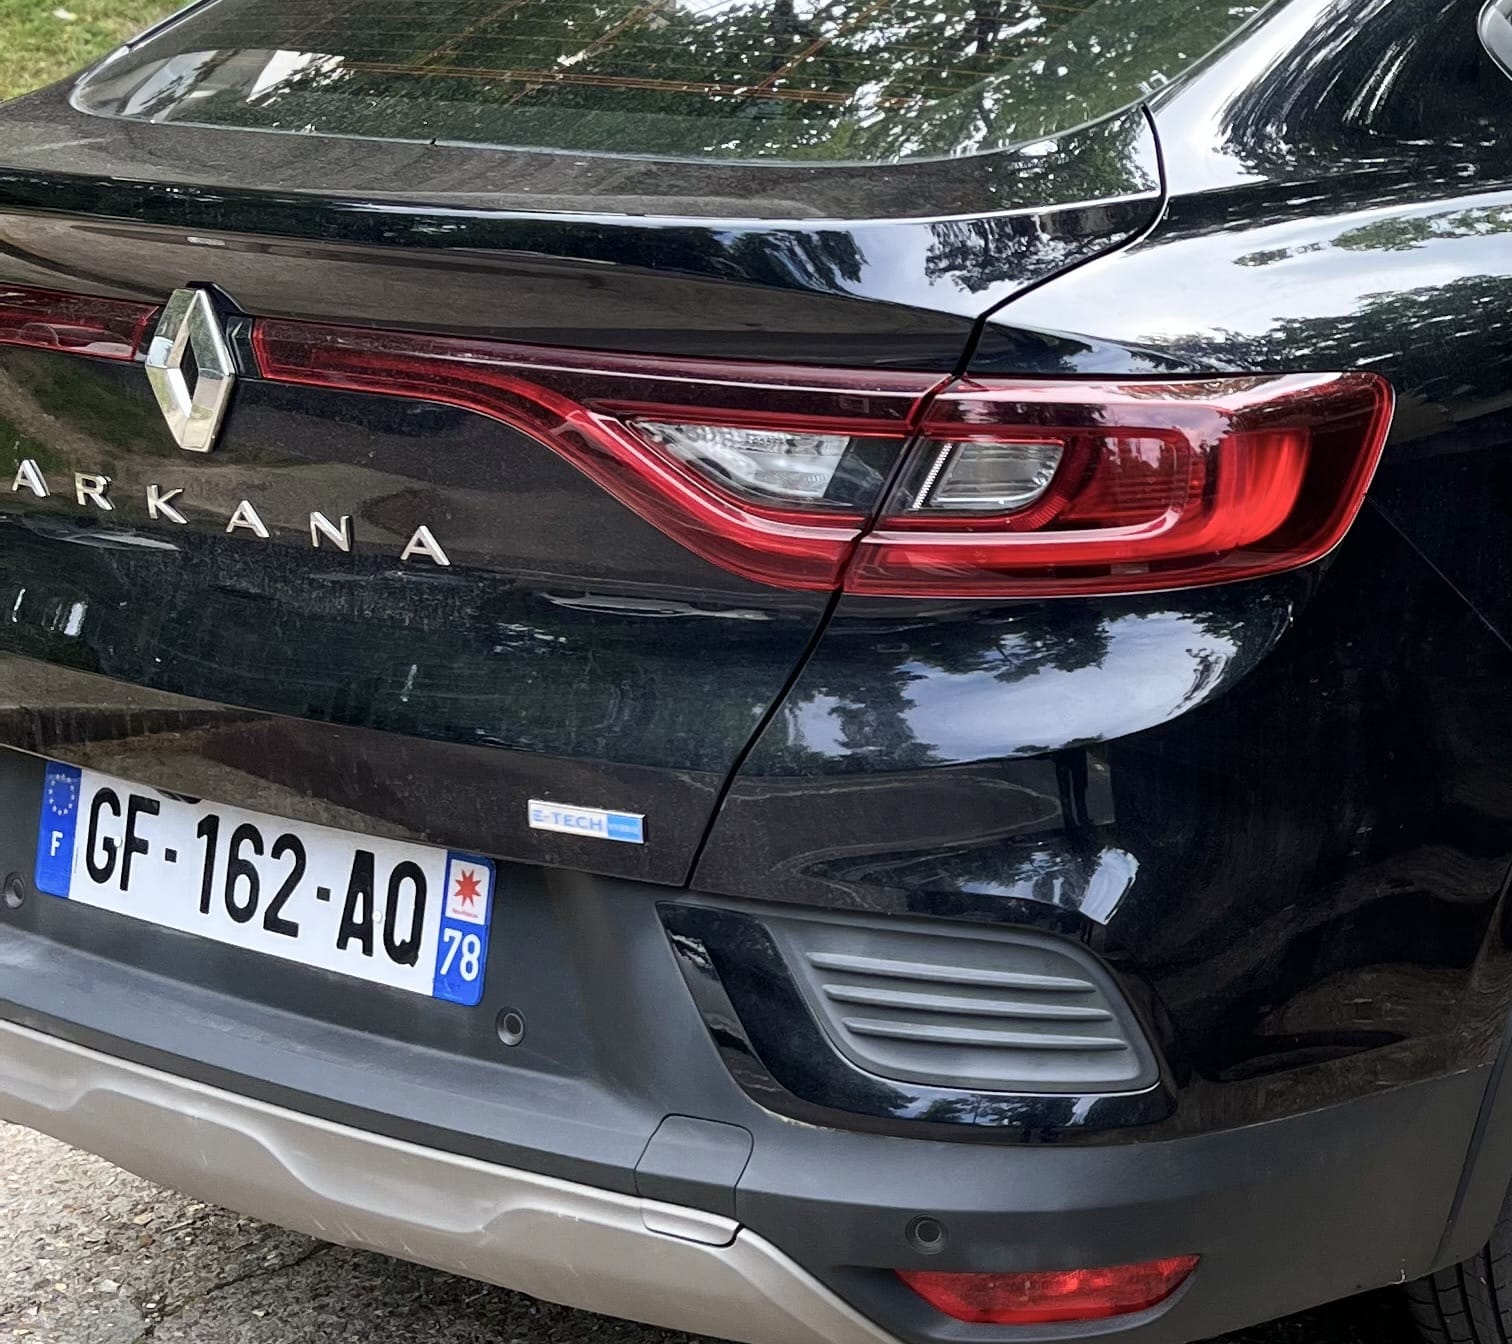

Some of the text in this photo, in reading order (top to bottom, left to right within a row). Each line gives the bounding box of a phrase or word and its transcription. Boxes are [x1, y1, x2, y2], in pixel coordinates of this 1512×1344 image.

[12, 459, 451, 566] ARKANA
[50, 830, 64, 857] F
[532, 809, 603, 831] E-TECH
[86, 786, 428, 968] GF-162-AQ
[440, 927, 481, 982] 78
